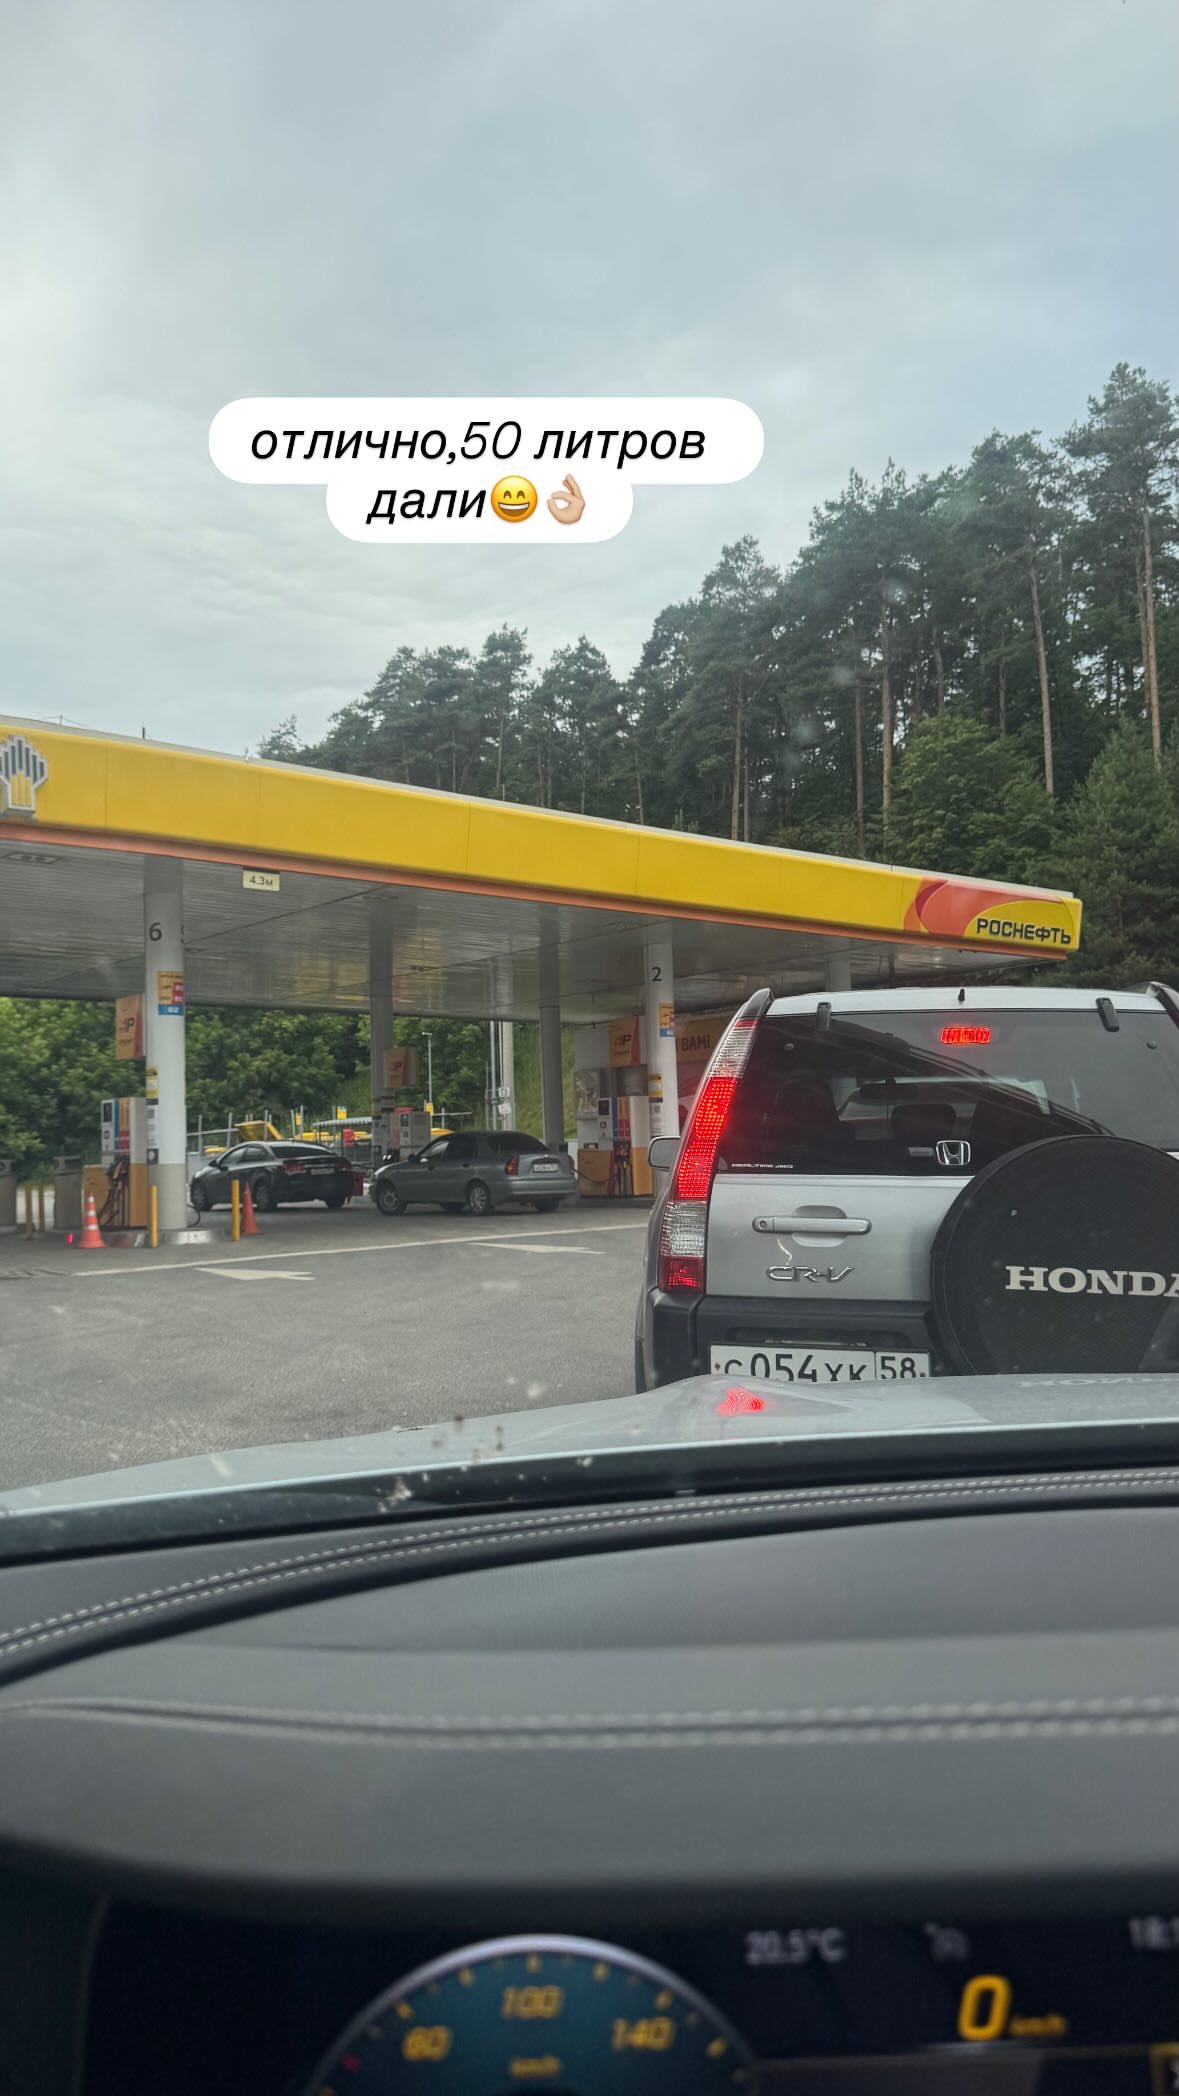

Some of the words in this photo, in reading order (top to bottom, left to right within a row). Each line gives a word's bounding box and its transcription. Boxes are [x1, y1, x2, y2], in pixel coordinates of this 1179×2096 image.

[149, 922, 162, 942] 6
[976, 918, 1072, 945] РОСНЕФТЬ
[651, 966, 662, 982] 2
[765, 1265, 856, 1284] CR-V
[880, 1356, 917, 1380] 58
[502, 1985, 564, 2019] 100
[959, 1975, 1012, 2041] 0
[612, 2017, 675, 2050] 140
